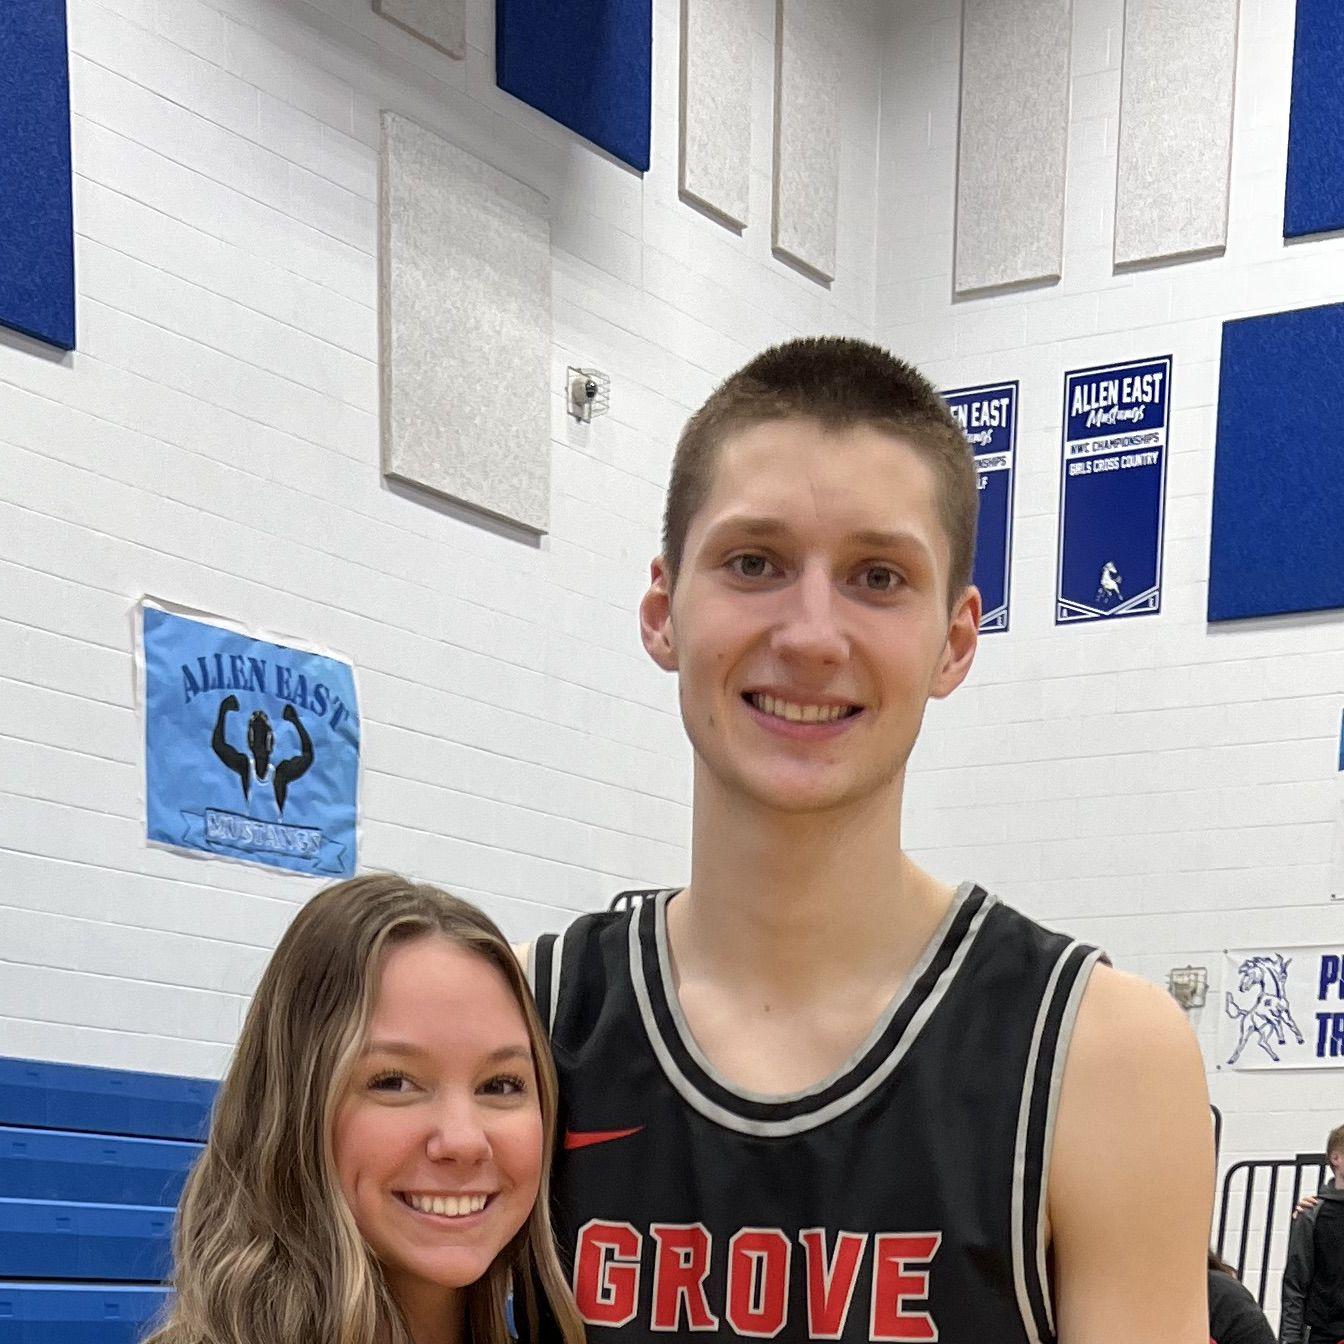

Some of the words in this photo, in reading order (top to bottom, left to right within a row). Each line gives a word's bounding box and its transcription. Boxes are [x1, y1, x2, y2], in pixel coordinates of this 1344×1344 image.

[1071, 379, 1119, 416] ALLEN
[1122, 372, 1164, 404] EAST
[971, 397, 1009, 428] EAST
[1085, 404, 1145, 428] Mustangs
[1092, 432, 1160, 451] CHAMPIONSHIPS
[1069, 460, 1092, 476] GIRLS
[1093, 455, 1119, 472] CROSS
[1121, 451, 1159, 470] COUNTRY
[181, 653, 267, 704] ALLEN
[275, 664, 350, 731] EAST
[574, 1218, 943, 1343] GROVE
